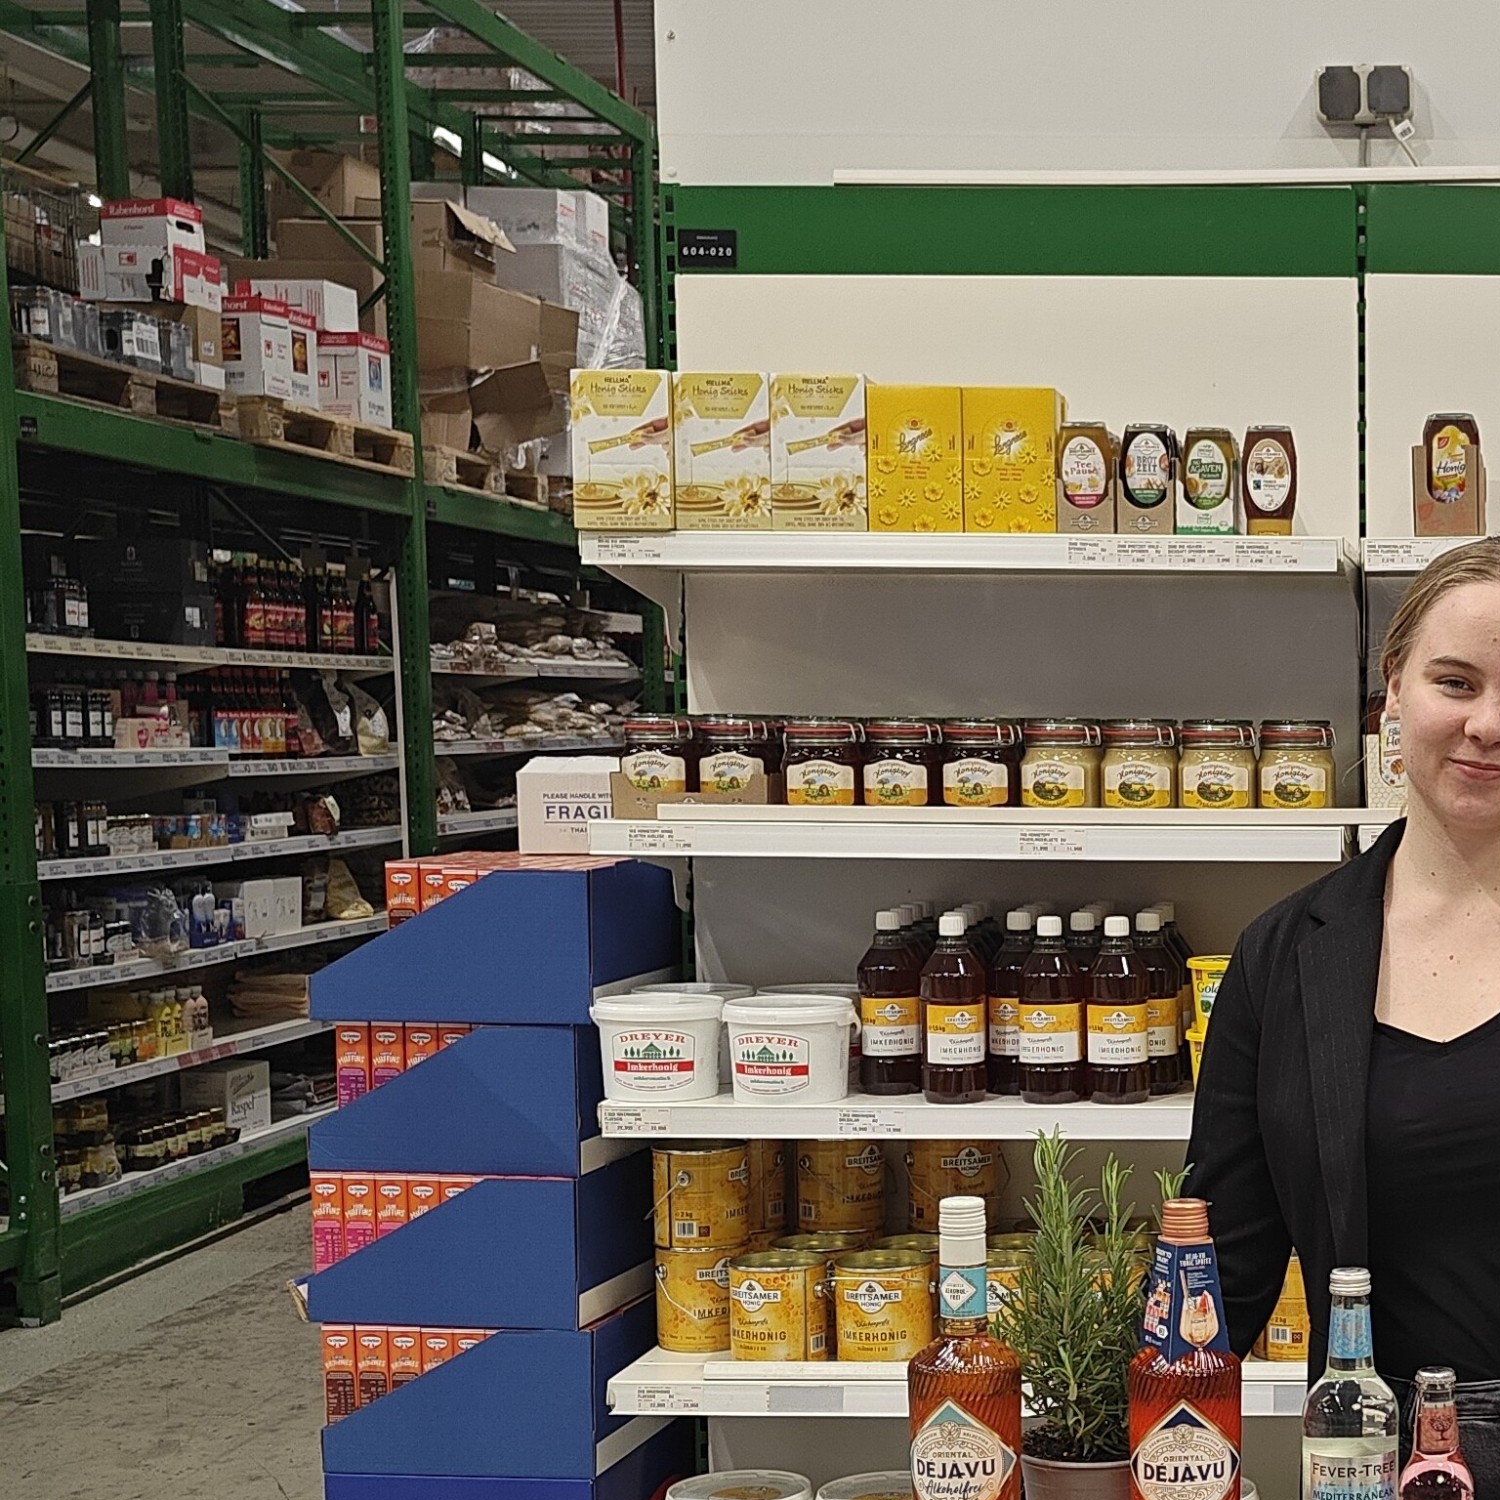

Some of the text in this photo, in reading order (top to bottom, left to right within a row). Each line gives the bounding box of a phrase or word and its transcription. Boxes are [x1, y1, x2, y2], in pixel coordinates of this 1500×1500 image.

[682, 246, 732, 257] 604-020
[590, 384, 647, 394] Honig Sticks
[693, 386, 748, 397] Honig Sticks
[788, 384, 844, 397] Honig Sticks
[1136, 464, 1158, 473] ZEIT
[1436, 461, 1466, 475] Honig
[546, 805, 608, 819] FRAGI
[620, 1033, 686, 1044] DREYER
[738, 1036, 800, 1048] DREYER
[627, 1062, 679, 1072] Imkerhonig
[744, 1066, 792, 1076] Imkerhonig
[943, 1155, 992, 1166] BREITSAMER
[698, 1270, 729, 1279] BREITS
[846, 1292, 900, 1301] BREITSAMER
[843, 1330, 908, 1342] IMKERHONIG
[932, 1451, 973, 1459] ORIENTAL
[1163, 1455, 1206, 1463] ORIENTAL
[1312, 1460, 1395, 1478] FEVER-TREE
[926, 1480, 985, 1500] Alkoholfrei
